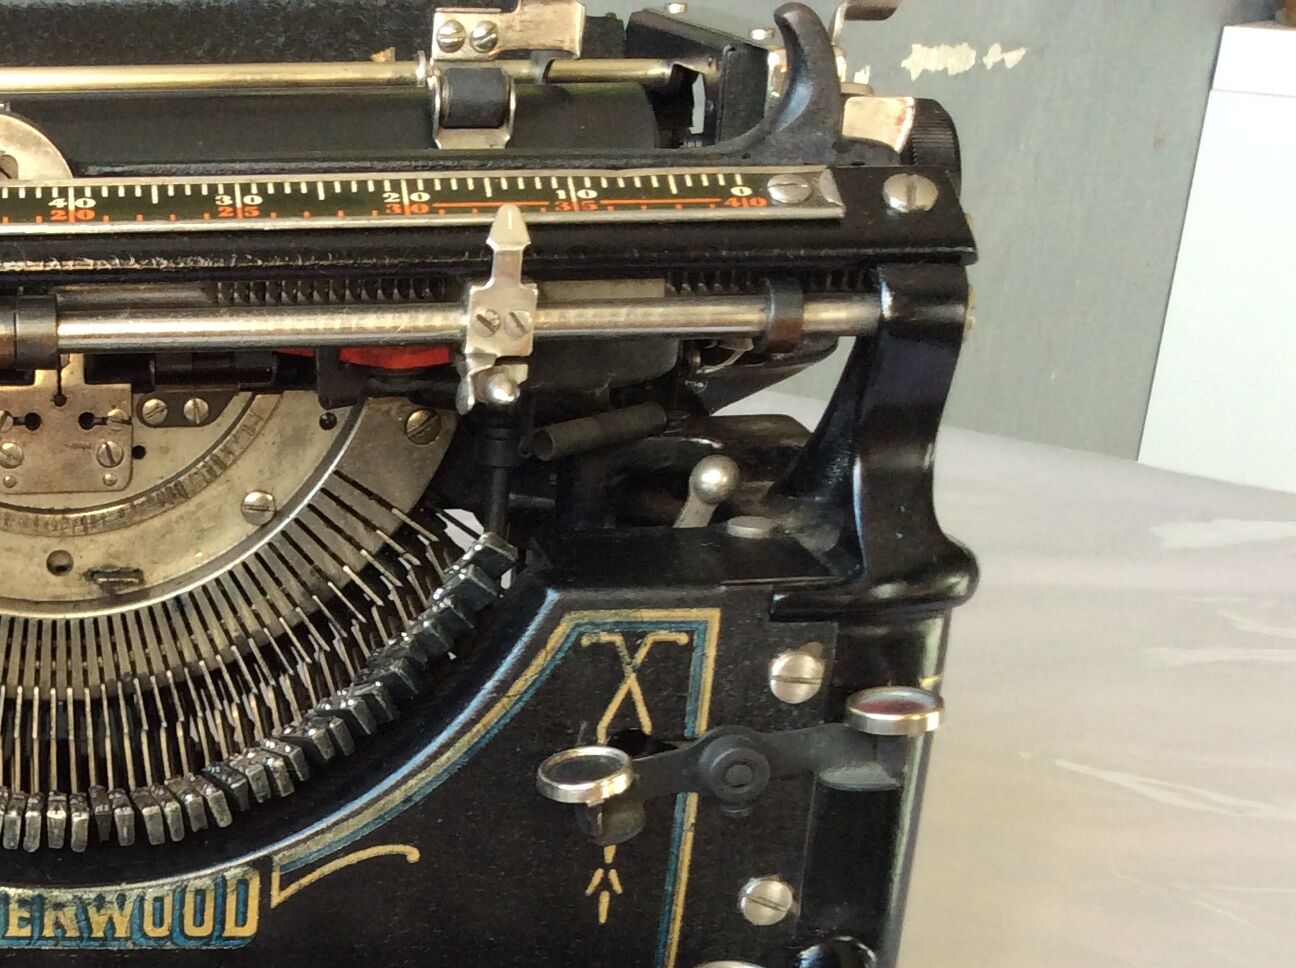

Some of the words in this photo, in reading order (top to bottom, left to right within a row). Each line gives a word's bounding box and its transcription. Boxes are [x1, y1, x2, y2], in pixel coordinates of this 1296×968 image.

[48, 197, 96, 209] 40
[215, 194, 263, 206] 30
[382, 191, 431, 203] 20
[556, 188, 598, 200] 10
[730, 186, 752, 196] 0
[50, 208, 95, 221] 20
[218, 206, 260, 218] 25
[385, 203, 430, 215] 30
[556, 200, 598, 212] 35
